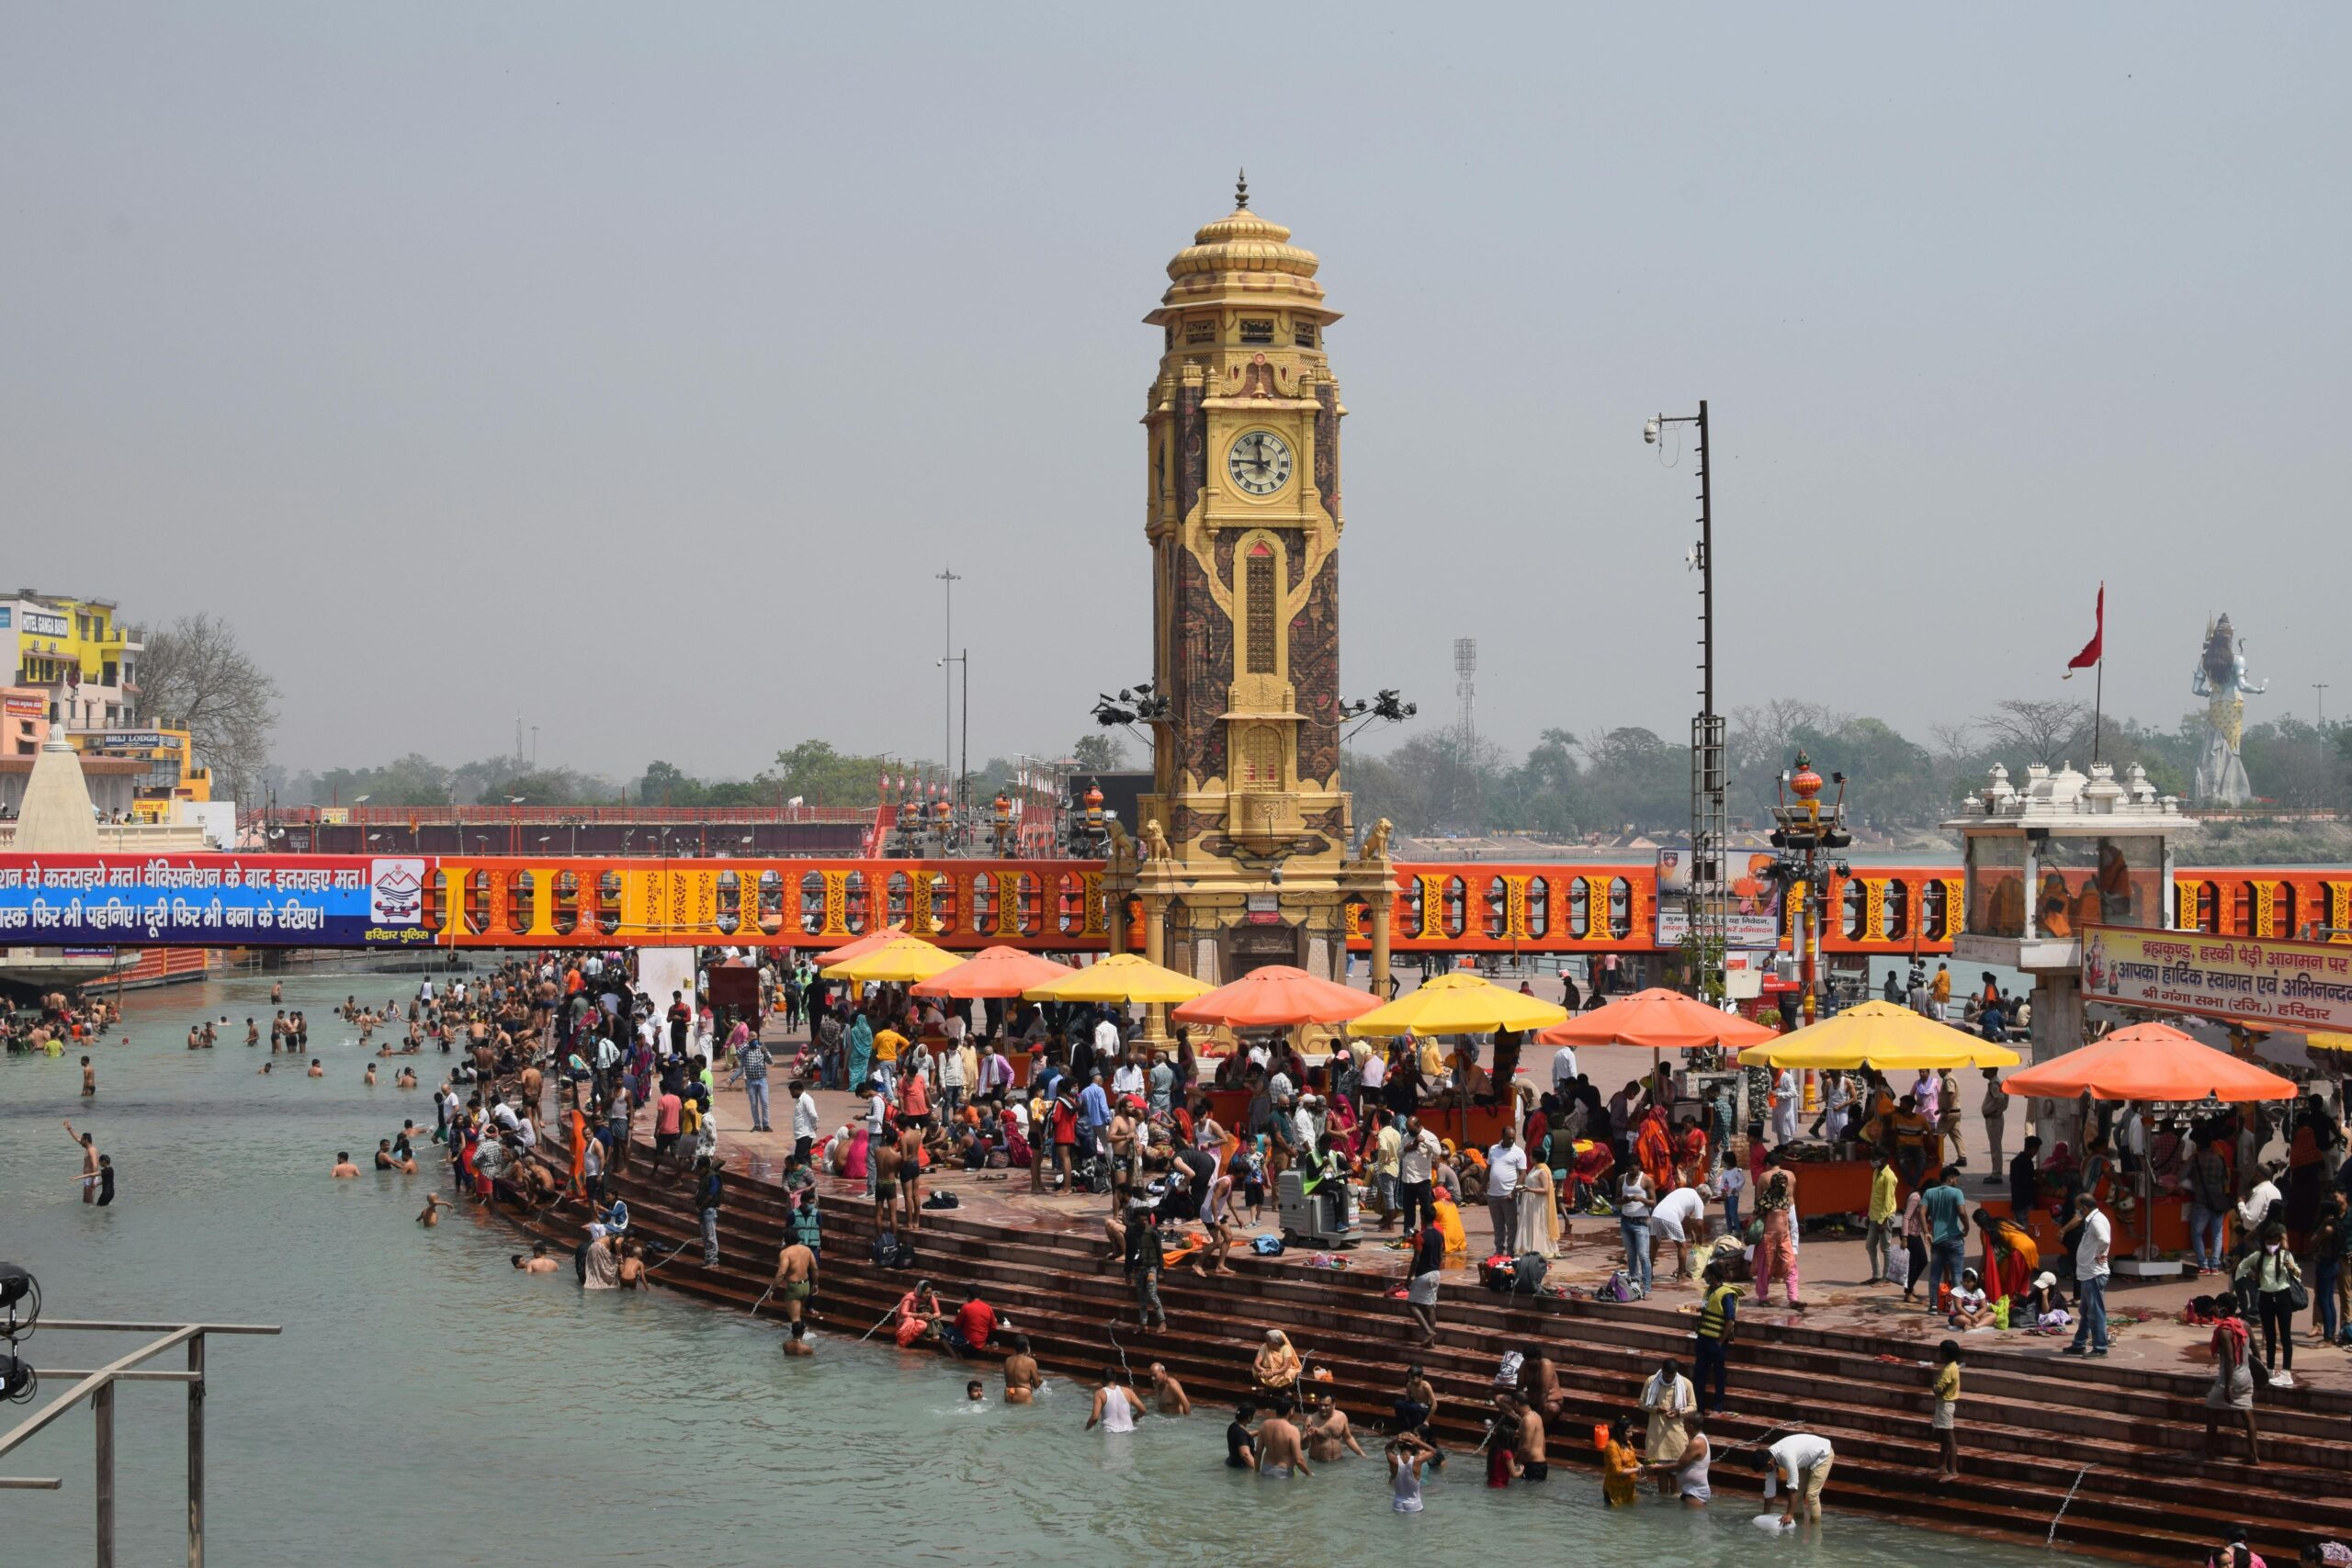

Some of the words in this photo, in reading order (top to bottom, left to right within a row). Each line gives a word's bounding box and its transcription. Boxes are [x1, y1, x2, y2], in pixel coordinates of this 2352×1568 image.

[22, 614, 38, 632] HOTEL
[38, 615, 54, 634] GANGA
[26, 860, 41, 889] से
[43, 860, 106, 892] कतराइये
[144, 858, 221, 889] वैक्सिनेशन
[224, 861, 241, 889] के
[244, 868, 272, 889] बाद
[276, 868, 332, 893] इतराइए
[32, 897, 62, 928] फिर
[63, 897, 82, 928] भी
[144, 897, 169, 938] दूरी
[172, 897, 202, 928] फिर
[204, 897, 221, 928] भी
[226, 907, 254, 928] बना
[257, 899, 275, 928] के
[364, 927, 399, 941] हरिद्वार
[400, 927, 429, 943] पुलिस
[2199, 942, 2235, 962] हरकी
[2238, 943, 2264, 968] पैड़ी
[2267, 951, 2324, 971] आगमन
[2327, 955, 2350, 972] पर
[2118, 961, 2159, 982] आपका
[2162, 960, 2204, 987] हार्दिक
[2206, 970, 2254, 993] स्वागत
[2256, 969, 2278, 996] एवं
[2142, 986, 2158, 1000] श्री
[2161, 989, 2192, 1003] गंगा
[2194, 994, 2224, 1009] सभा
[2228, 997, 2272, 1016] (रजि.)
[2277, 1001, 2332, 1021] हरिद्वार
